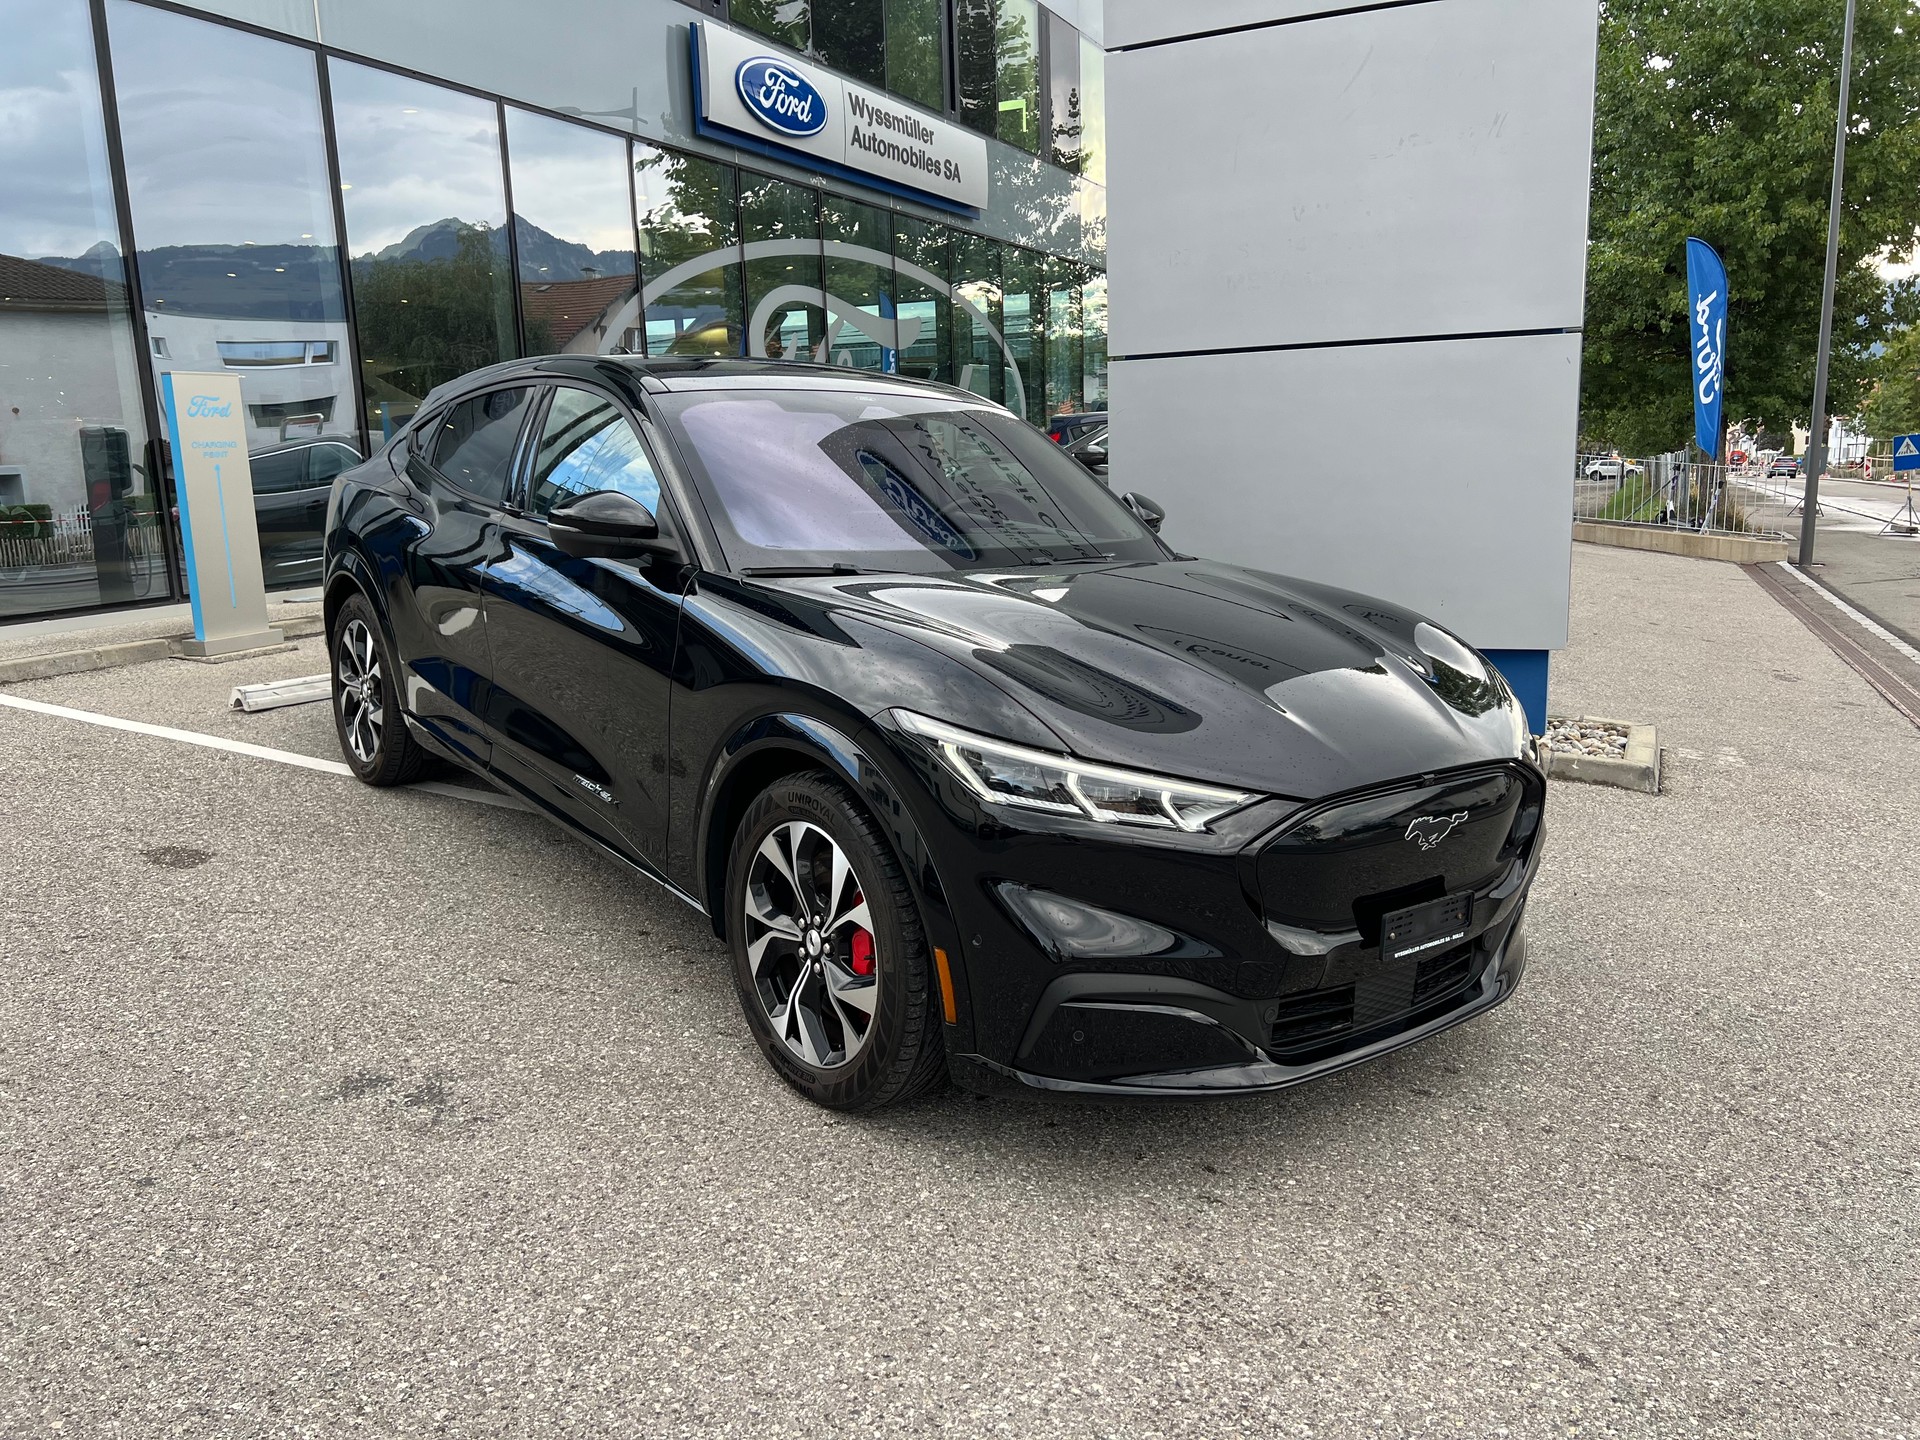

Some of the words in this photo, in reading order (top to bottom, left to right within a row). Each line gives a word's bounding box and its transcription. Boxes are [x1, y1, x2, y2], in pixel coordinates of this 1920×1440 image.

[759, 67, 812, 123] Ford
[848, 91, 935, 146] Wyssmüller
[850, 124, 942, 176] Automobiles
[943, 160, 962, 183] SA
[1696, 289, 1722, 404] Ford
[187, 394, 232, 418] Ford
[191, 440, 237, 449] CHARGING
[202, 450, 229, 459] POINT
[787, 791, 837, 827] UNIROYAL
